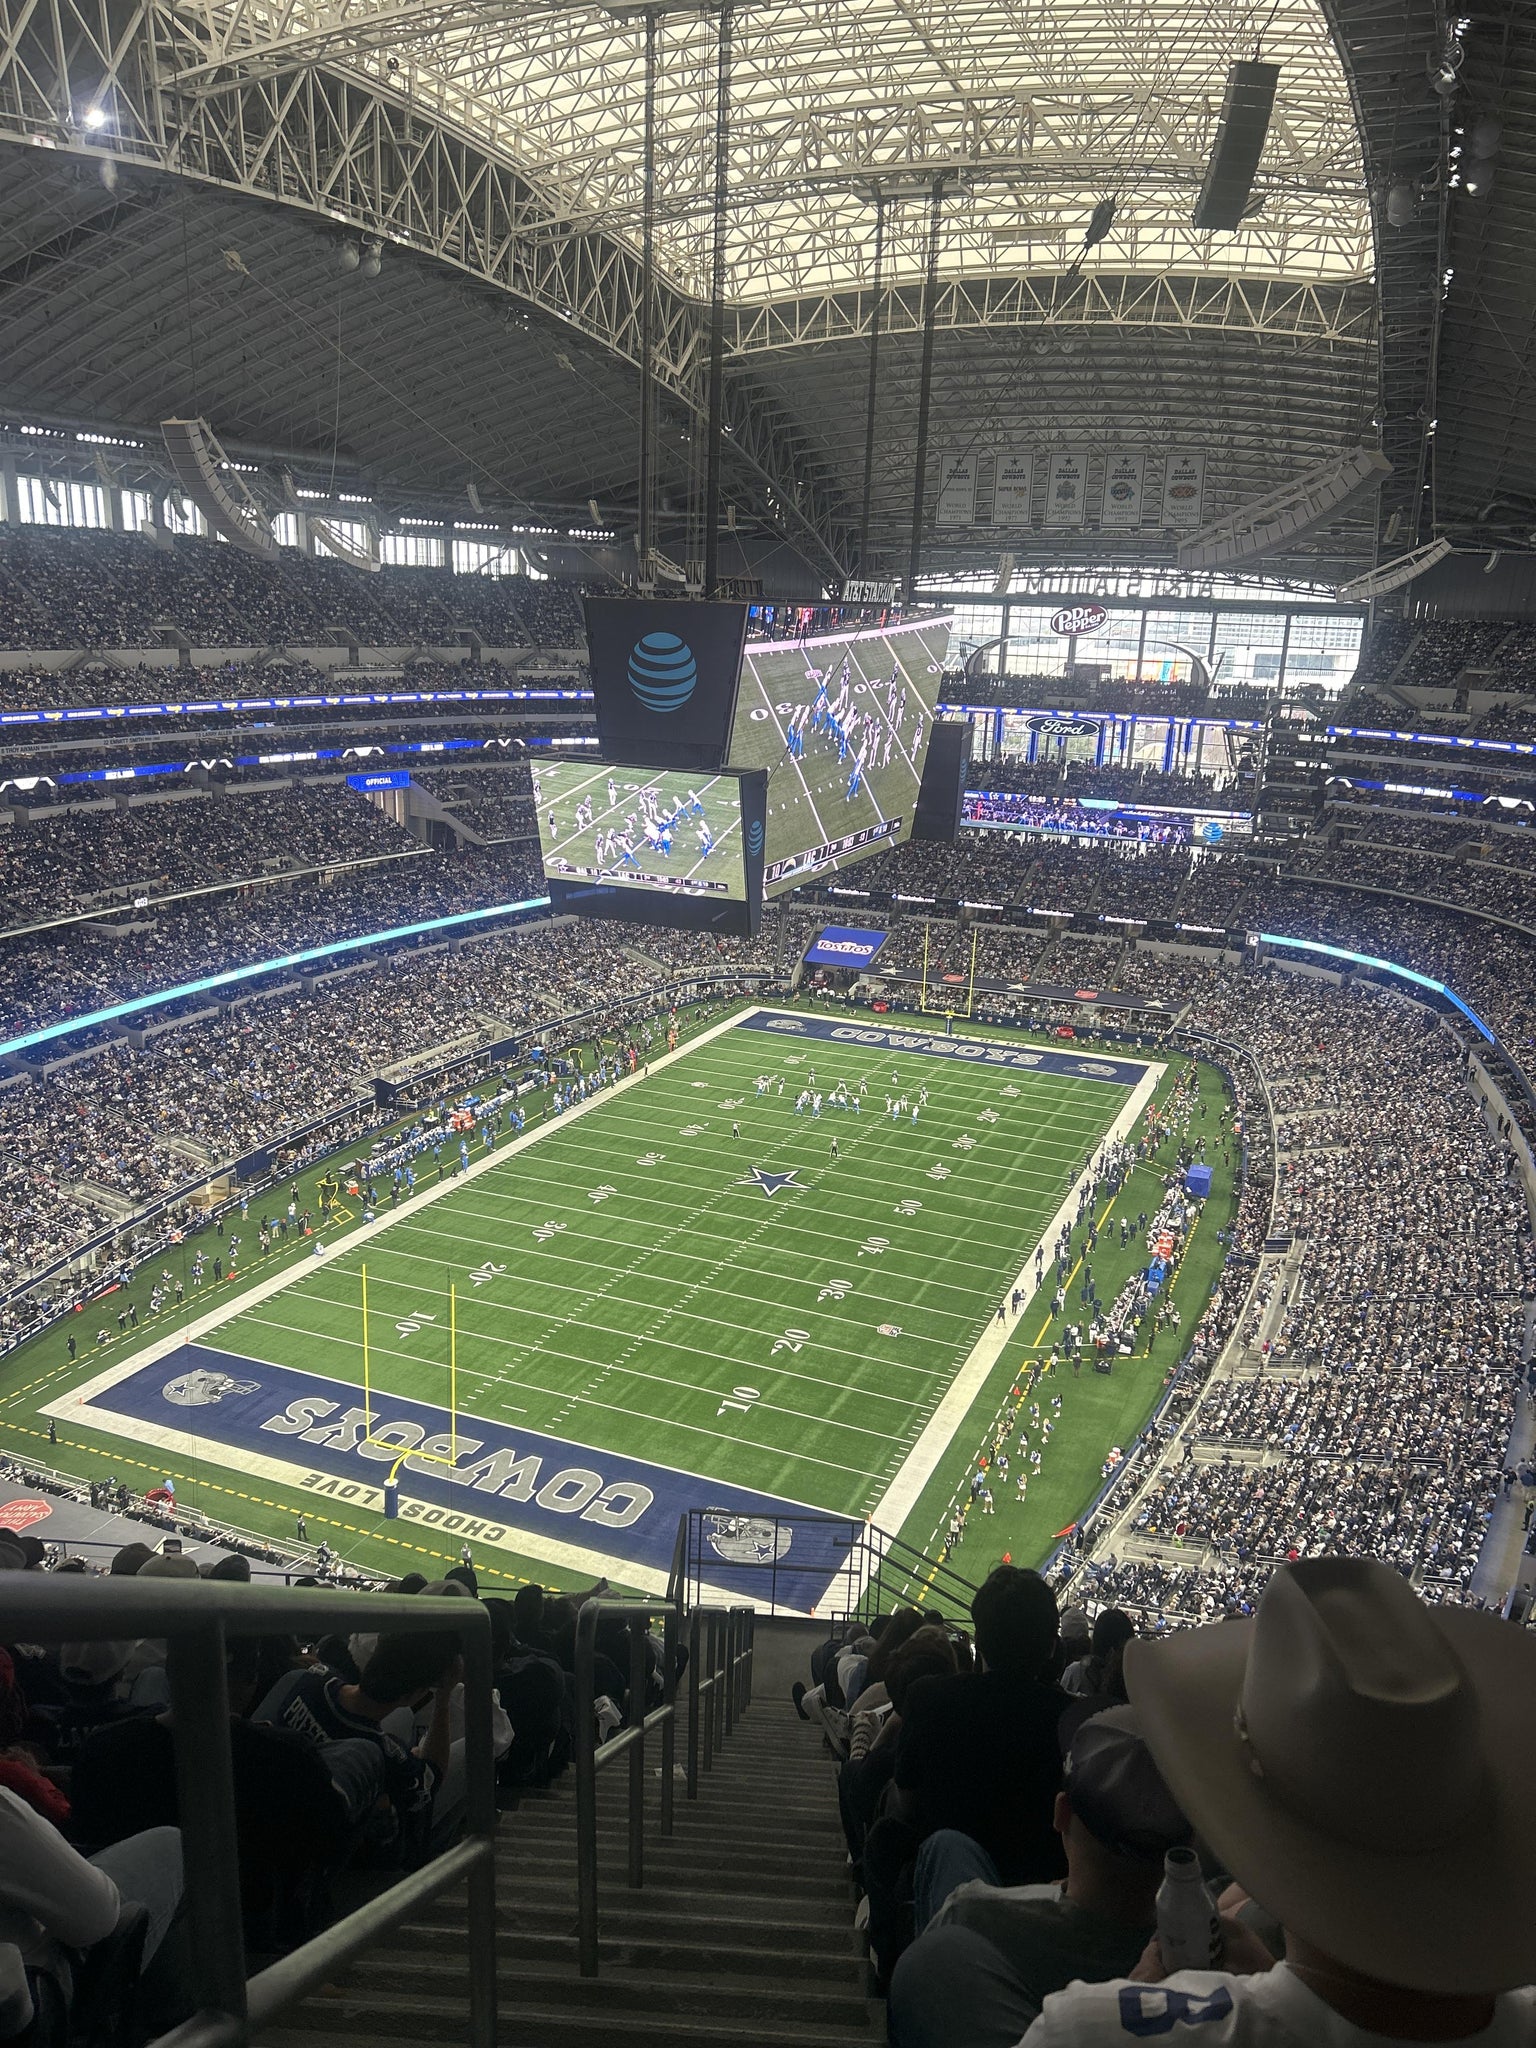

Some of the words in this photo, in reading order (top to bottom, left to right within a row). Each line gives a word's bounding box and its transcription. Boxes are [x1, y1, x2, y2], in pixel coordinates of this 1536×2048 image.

[842, 581, 864, 602] AT&T
[863, 582, 896, 603] STADIUM
[1058, 610, 1105, 632] Pepper
[1072, 607, 1092, 620] Dr
[1040, 718, 1085, 735] Ford
[365, 776, 392, 786] OFFICIAL
[830, 1026, 1044, 1066] COWBOYS
[636, 1152, 667, 1166] 50
[587, 1184, 618, 1200] 40
[893, 1199, 923, 1216] 50
[532, 1220, 568, 1238] 30
[860, 1236, 890, 1255] 40
[468, 1261, 508, 1282] 20
[819, 1279, 854, 1300] 30
[395, 1310, 438, 1333] 10
[773, 1328, 811, 1353] 20
[721, 1386, 761, 1414] 10
[259, 1397, 655, 1528] COWBOYS
[299, 1473, 380, 1505] LOVE
[398, 1499, 508, 1542] CHOOS
